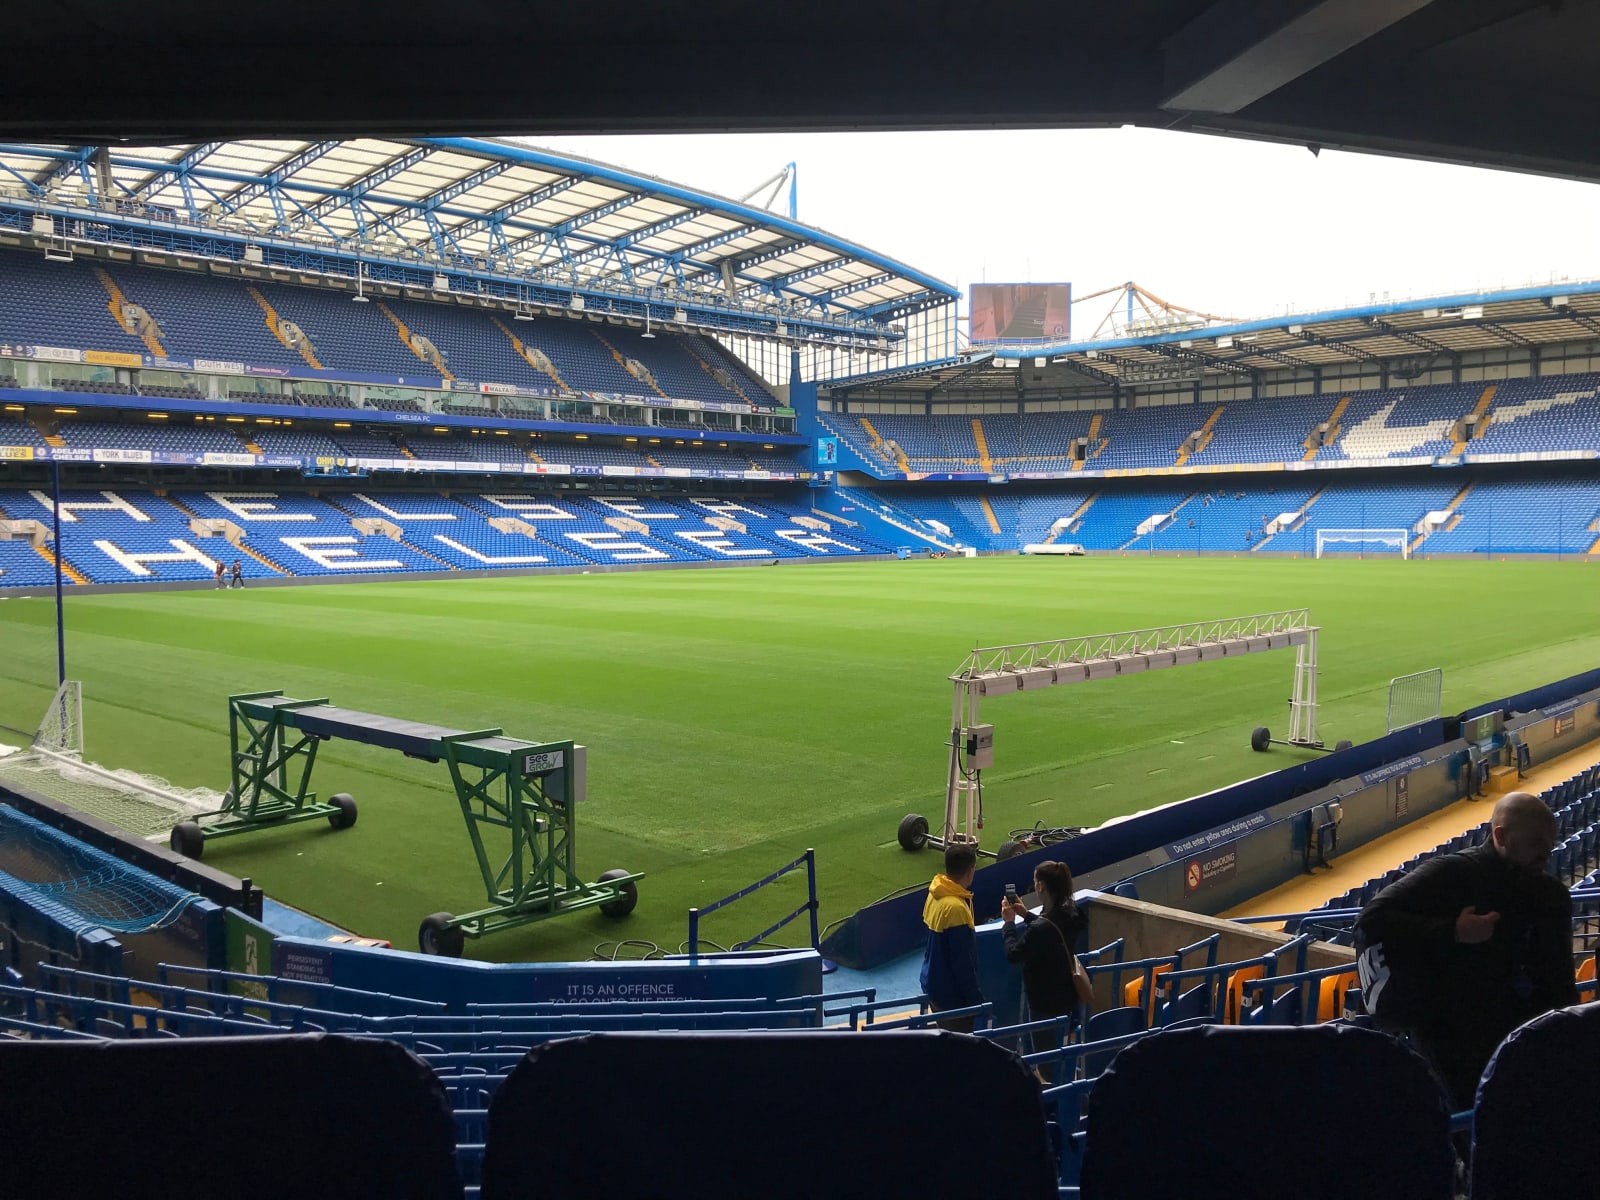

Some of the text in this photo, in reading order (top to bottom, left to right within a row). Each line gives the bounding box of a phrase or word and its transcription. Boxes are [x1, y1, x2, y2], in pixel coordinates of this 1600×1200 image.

[195, 360, 221, 369] SOUTH
[223, 362, 244, 371] WEST
[395, 414, 422, 422] CHELSEA
[101, 450, 144, 459] YORK BLUES
[316, 456, 334, 466] OHIO
[529, 760, 555, 772] GROW
[1173, 845, 1183, 854] Do
[1183, 840, 1193, 850] not
[1192, 837, 1205, 847] enter
[1205, 832, 1221, 844] yellow
[1231, 821, 1248, 832] during
[1251, 814, 1265, 825] match
[1202, 852, 1235, 872] NO SMOKING
[286, 963, 316, 974] STANDING
[281, 971, 330, 984] NOT PERMITTED
[567, 983, 675, 996] IT IS AN OFFENCE
